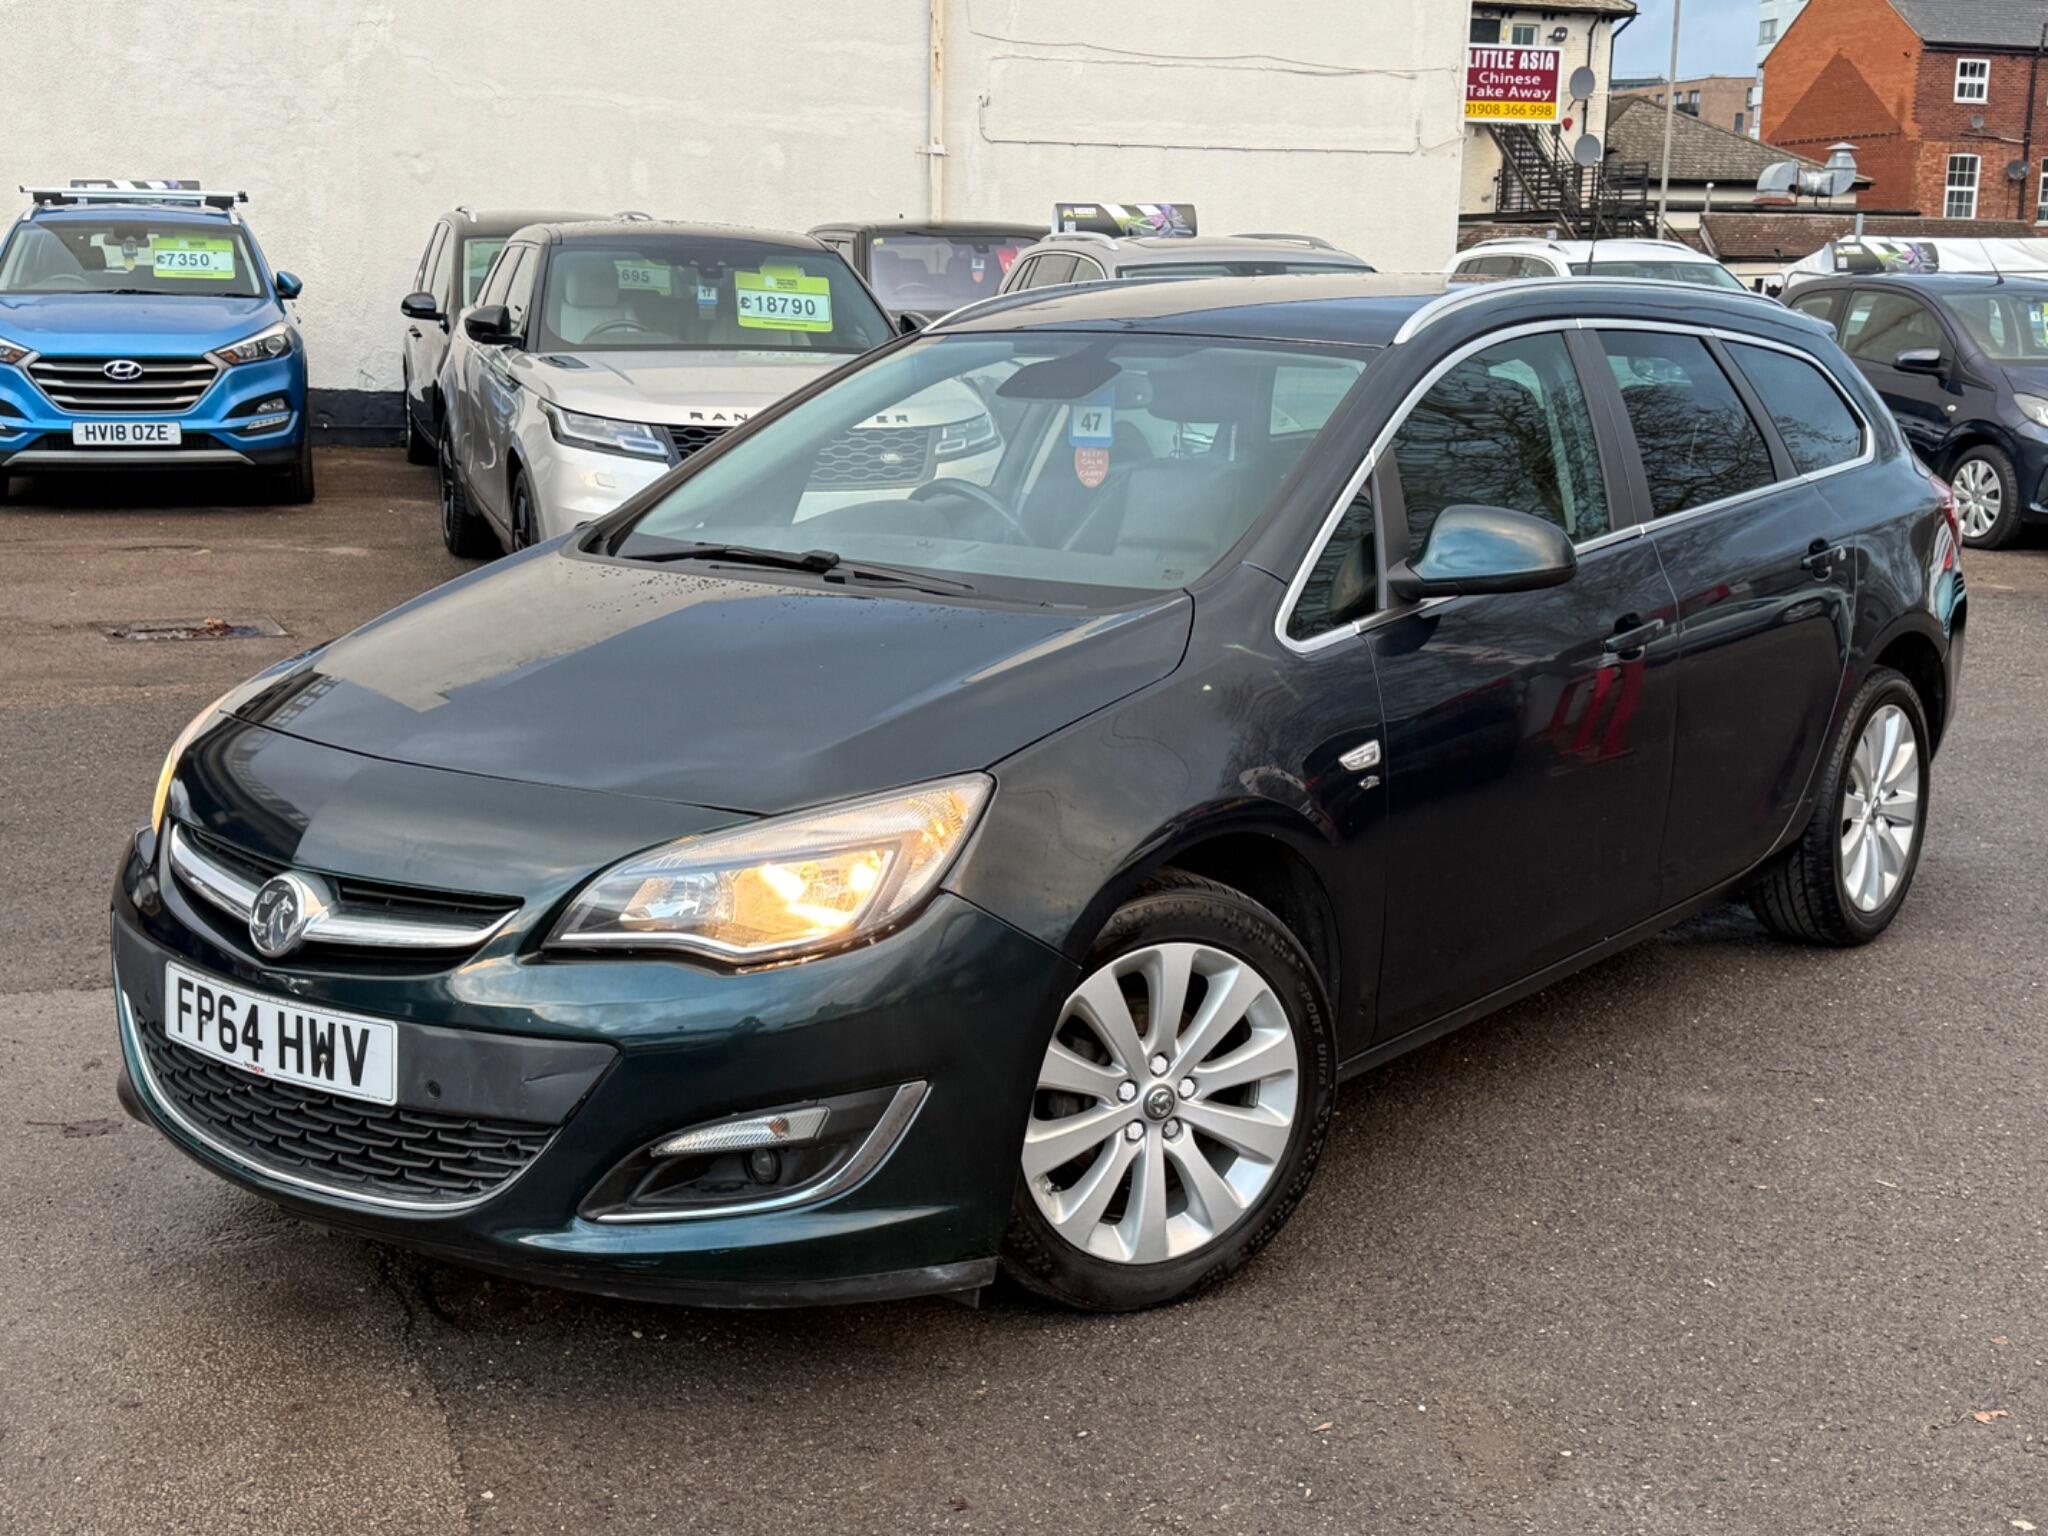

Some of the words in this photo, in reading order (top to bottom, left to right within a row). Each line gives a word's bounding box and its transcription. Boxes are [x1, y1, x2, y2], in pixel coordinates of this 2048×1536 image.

[1468, 50, 1515, 69] LITTLE
[1519, 51, 1555, 71] ASIA
[1478, 72, 1541, 85] Chinese
[1468, 85, 1504, 97] Take
[1508, 86, 1551, 101] Away
[1465, 103, 1500, 114] 01908
[1504, 104, 1526, 116] 366
[1530, 105, 1552, 116] 998
[740, 296, 816, 315] £18790
[689, 412, 748, 422] RAN
[1081, 413, 1102, 432] 47
[84, 425, 126, 441] HV18
[132, 424, 168, 441] OZE
[178, 976, 263, 1063] FP64
[278, 1010, 371, 1087] HWV
